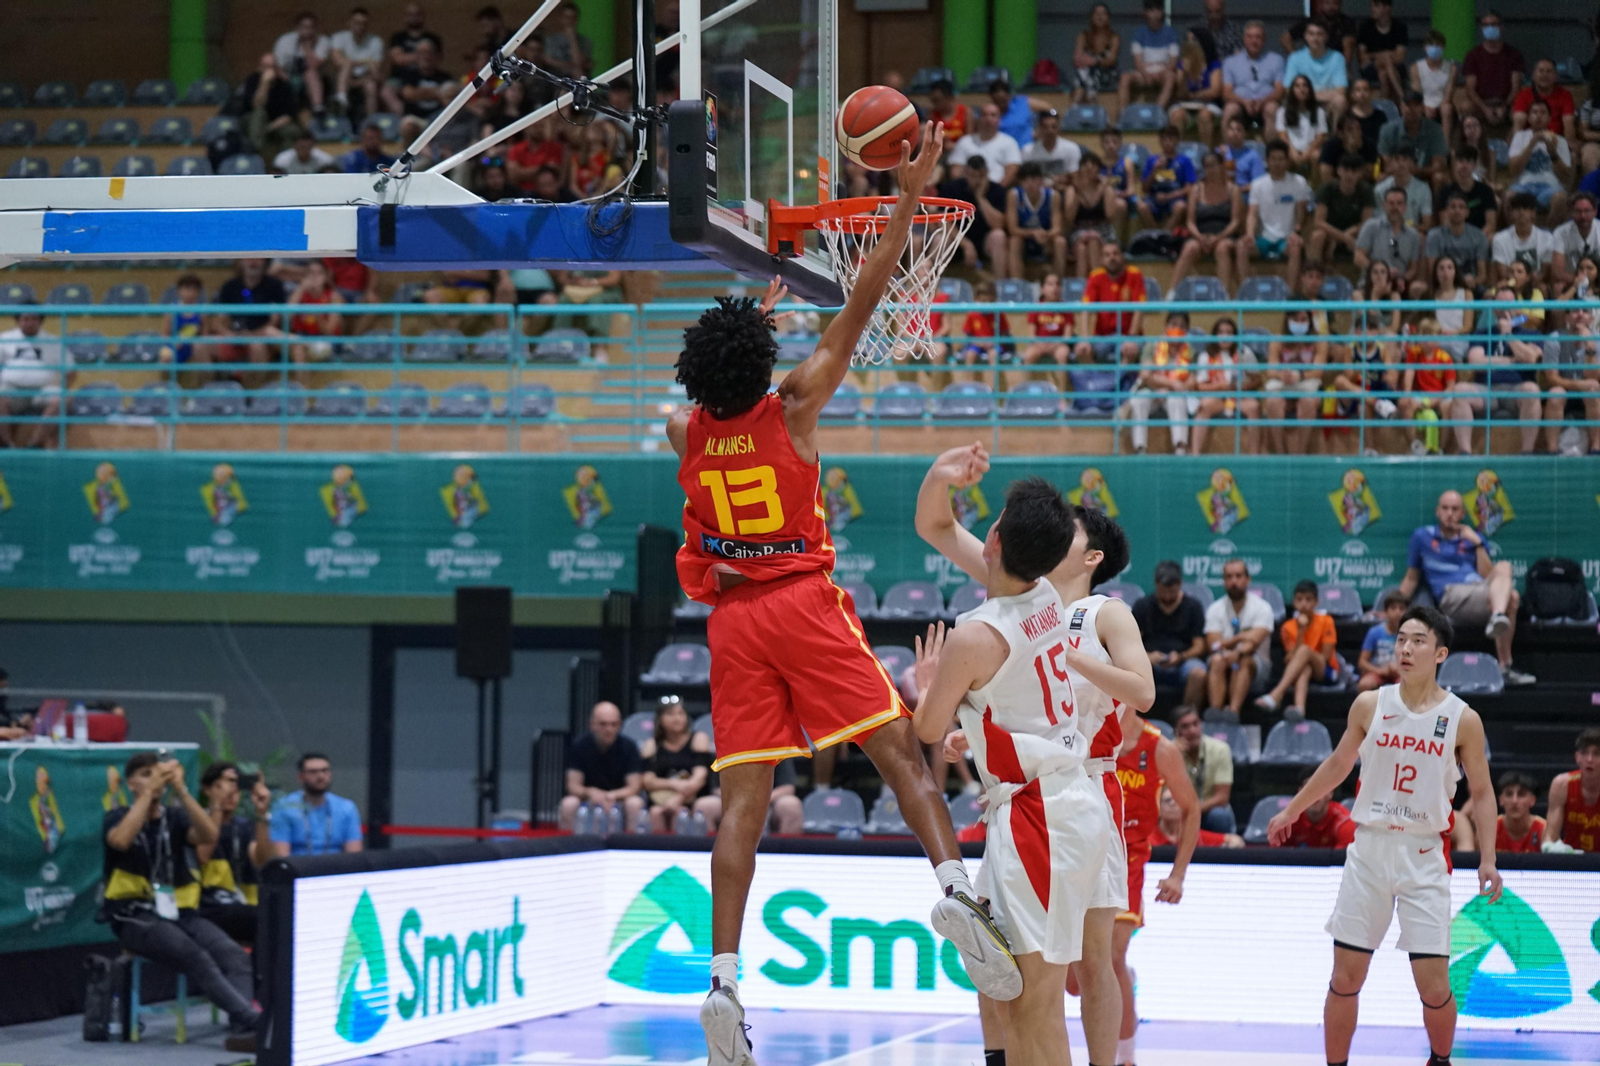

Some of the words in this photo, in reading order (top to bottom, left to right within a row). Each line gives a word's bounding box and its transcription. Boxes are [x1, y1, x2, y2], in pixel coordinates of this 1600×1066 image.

[705, 434, 755, 456] ALMANSA
[699, 465, 785, 535] 13
[1183, 556, 1211, 576] U17
[1314, 557, 1342, 577] U17
[1582, 559, 1600, 578] U1
[1019, 602, 1061, 642] WATANABE
[1034, 642, 1073, 726] 15
[1376, 733, 1444, 757] JAPAN
[1392, 763, 1417, 794] 12
[397, 894, 526, 1020] Smart
